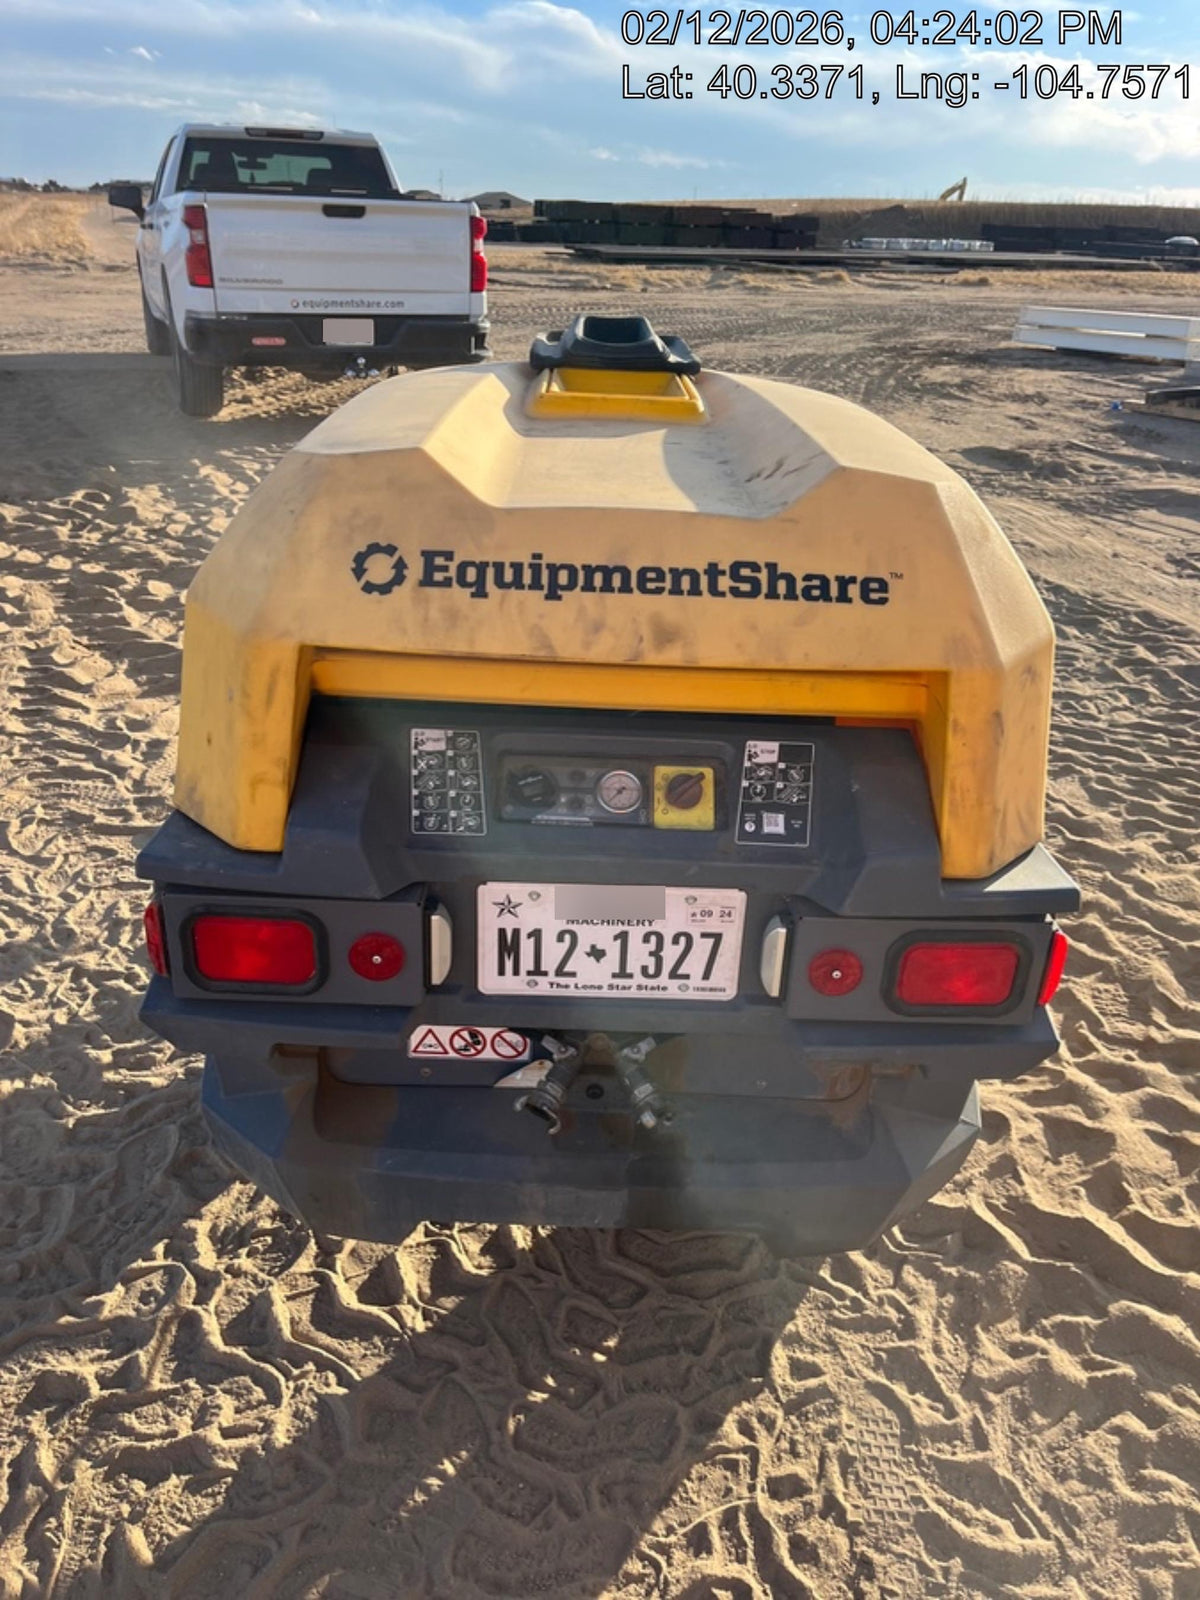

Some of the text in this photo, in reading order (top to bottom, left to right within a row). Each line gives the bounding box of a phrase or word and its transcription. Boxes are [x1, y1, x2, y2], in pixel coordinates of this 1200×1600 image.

[302, 299, 405, 309] equipmentshare.com
[418, 549, 890, 606] EquipmentShare
[700, 909, 733, 919] 09 24
[497, 927, 724, 982] M12 1327
[547, 980, 669, 992] The Lone Star State
